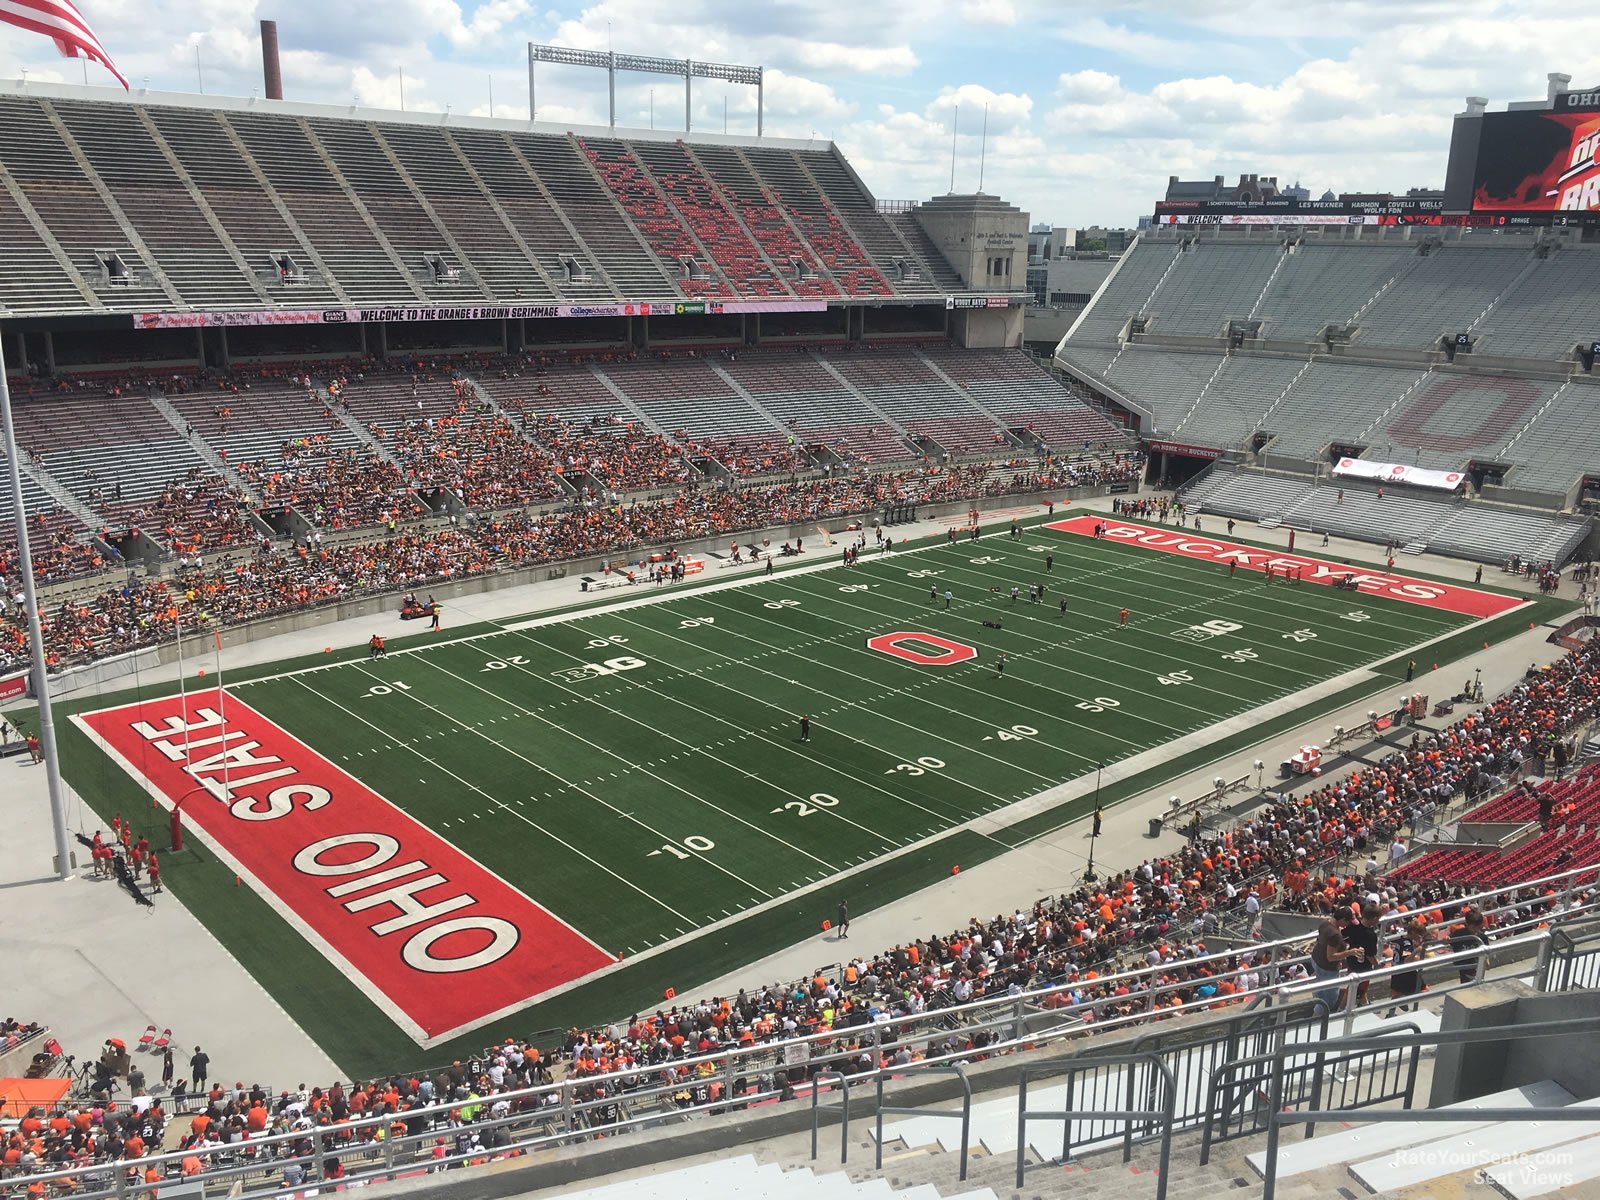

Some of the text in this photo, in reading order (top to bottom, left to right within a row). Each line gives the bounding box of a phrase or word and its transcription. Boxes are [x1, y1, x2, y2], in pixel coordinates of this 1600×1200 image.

[1187, 215, 1223, 224] WELCOME
[360, 306, 559, 321] WELCOME TO THE ORANGE & BROWN SCRIMMAGE
[1161, 444, 1178, 452] HOME
[1188, 448, 1218, 458] BUCKEYES
[1104, 526, 1447, 599] BUCKEYES
[839, 583, 870, 593] 40
[763, 598, 801, 610] 50
[684, 616, 715, 629] 40
[589, 635, 629, 648] 30
[1282, 630, 1318, 643] 20
[866, 630, 979, 666] O
[485, 655, 531, 670] 20
[1221, 649, 1259, 663] 30
[1156, 671, 1194, 687] 40
[369, 681, 412, 695] 10
[1075, 697, 1121, 713] 50
[996, 724, 1040, 744] 40
[130, 707, 332, 822] STATE
[897, 756, 946, 776] 30
[784, 792, 840, 817] 20
[661, 835, 715, 860] 10
[291, 832, 521, 973] OHIO
[697, 1087, 709, 1099] 16
[142, 1126, 153, 1137] 23
